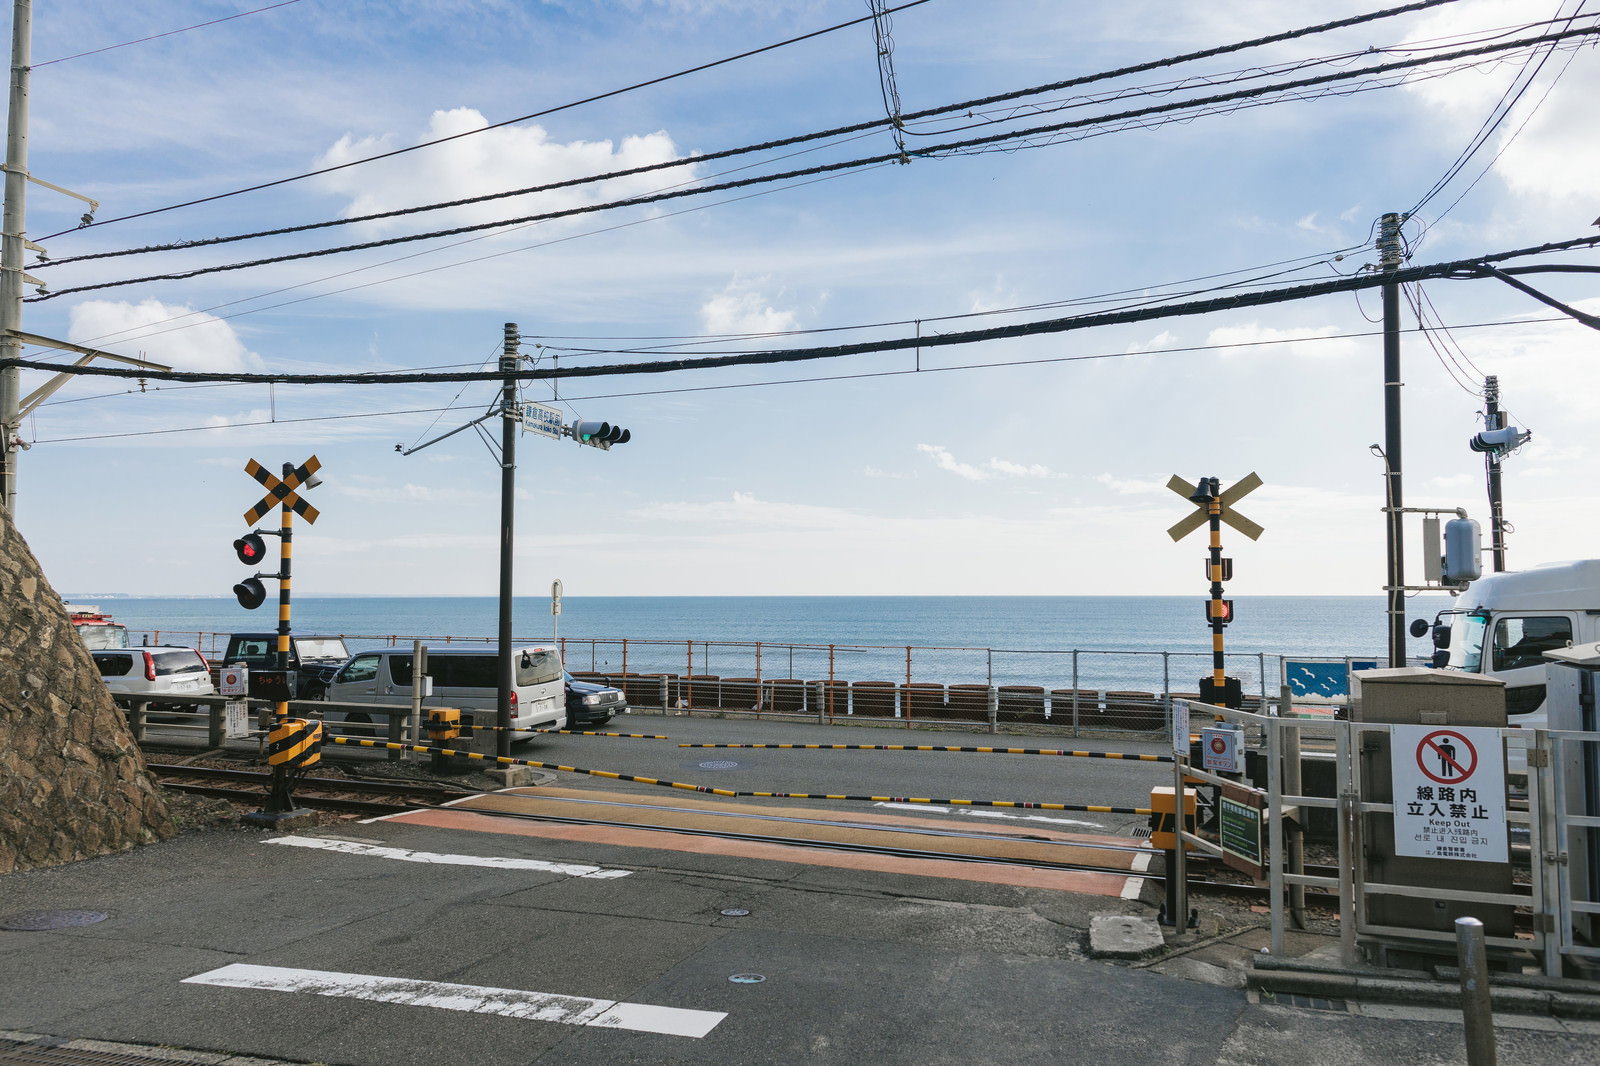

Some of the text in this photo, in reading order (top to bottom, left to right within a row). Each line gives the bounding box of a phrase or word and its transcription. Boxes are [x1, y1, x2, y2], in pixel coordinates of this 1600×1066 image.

[1416, 786, 1477, 803] 線路内
[1407, 801, 1489, 820] 立入禁止
[1429, 819, 1470, 828] Keep Out
[1414, 834, 1488, 846] 선로 내 진입 금지
